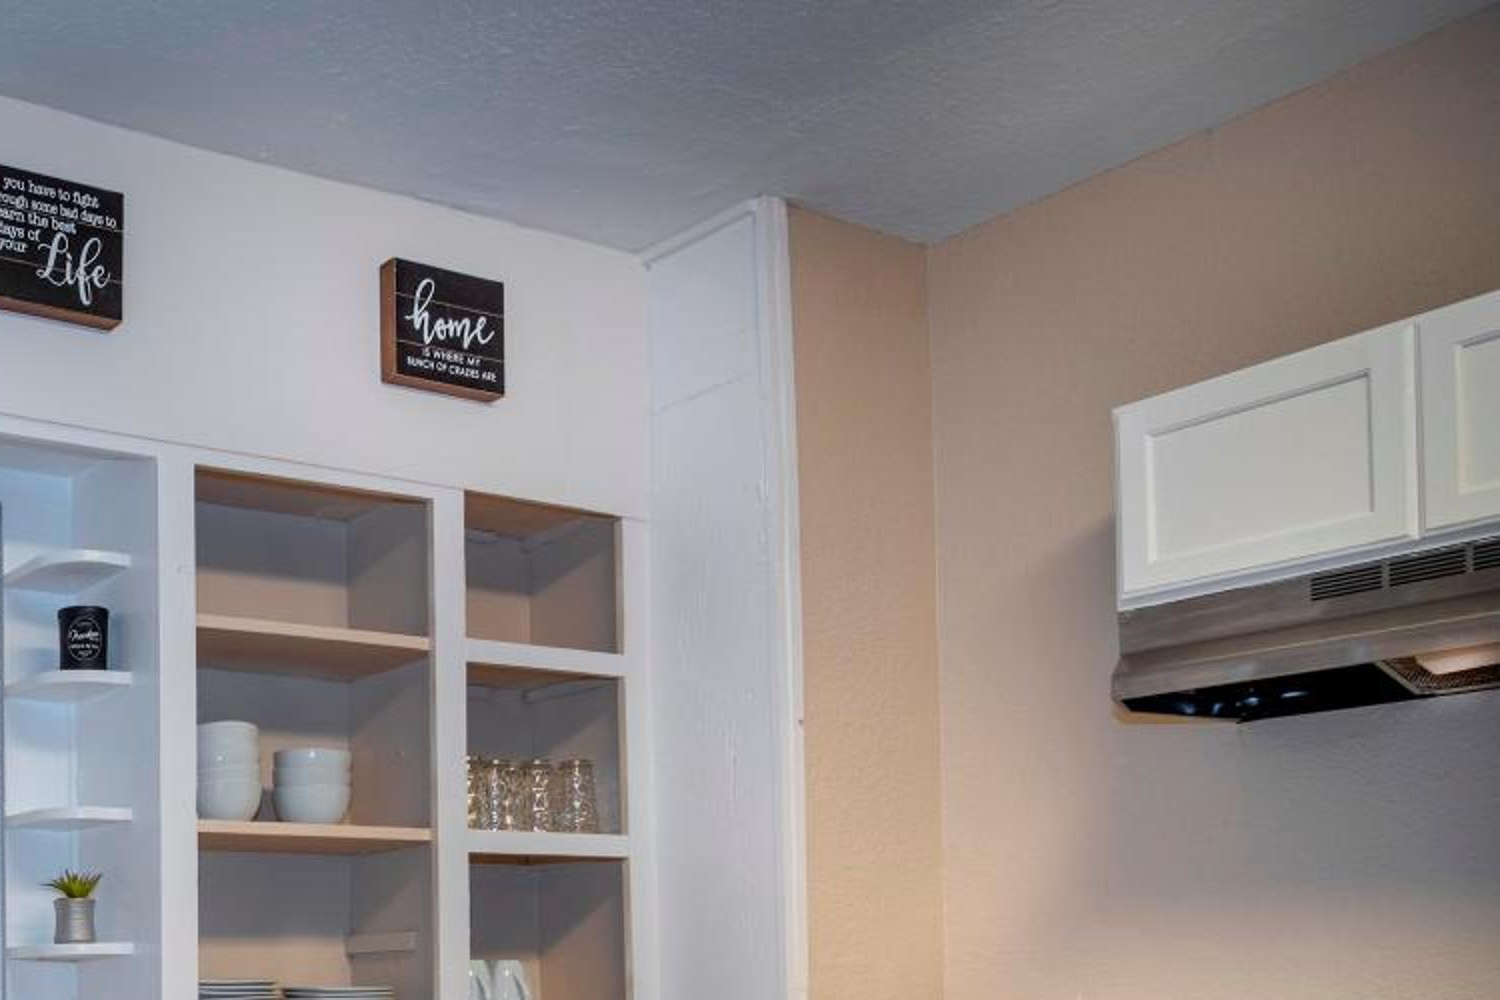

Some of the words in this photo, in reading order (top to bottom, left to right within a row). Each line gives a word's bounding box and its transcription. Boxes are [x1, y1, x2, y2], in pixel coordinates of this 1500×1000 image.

[3, 177, 25, 191] you
[28, 180, 57, 199] have
[58, 188, 71, 202] to
[72, 191, 100, 209] fight
[28, 212, 48, 229] the
[51, 216, 77, 234] best
[31, 200, 58, 215] some
[60, 203, 79, 219] bad
[80, 209, 104, 227] days
[105, 216, 117, 229] to
[27, 229, 41, 242] of
[36, 232, 111, 306] Life
[404, 278, 495, 349] home
[406, 356, 435, 370] BUNCH
[436, 361, 447, 372] OF
[482, 371, 497, 382] ARE
[421, 347, 431, 357] IS
[433, 350, 464, 365] WHERE
[467, 357, 481, 367] MY
